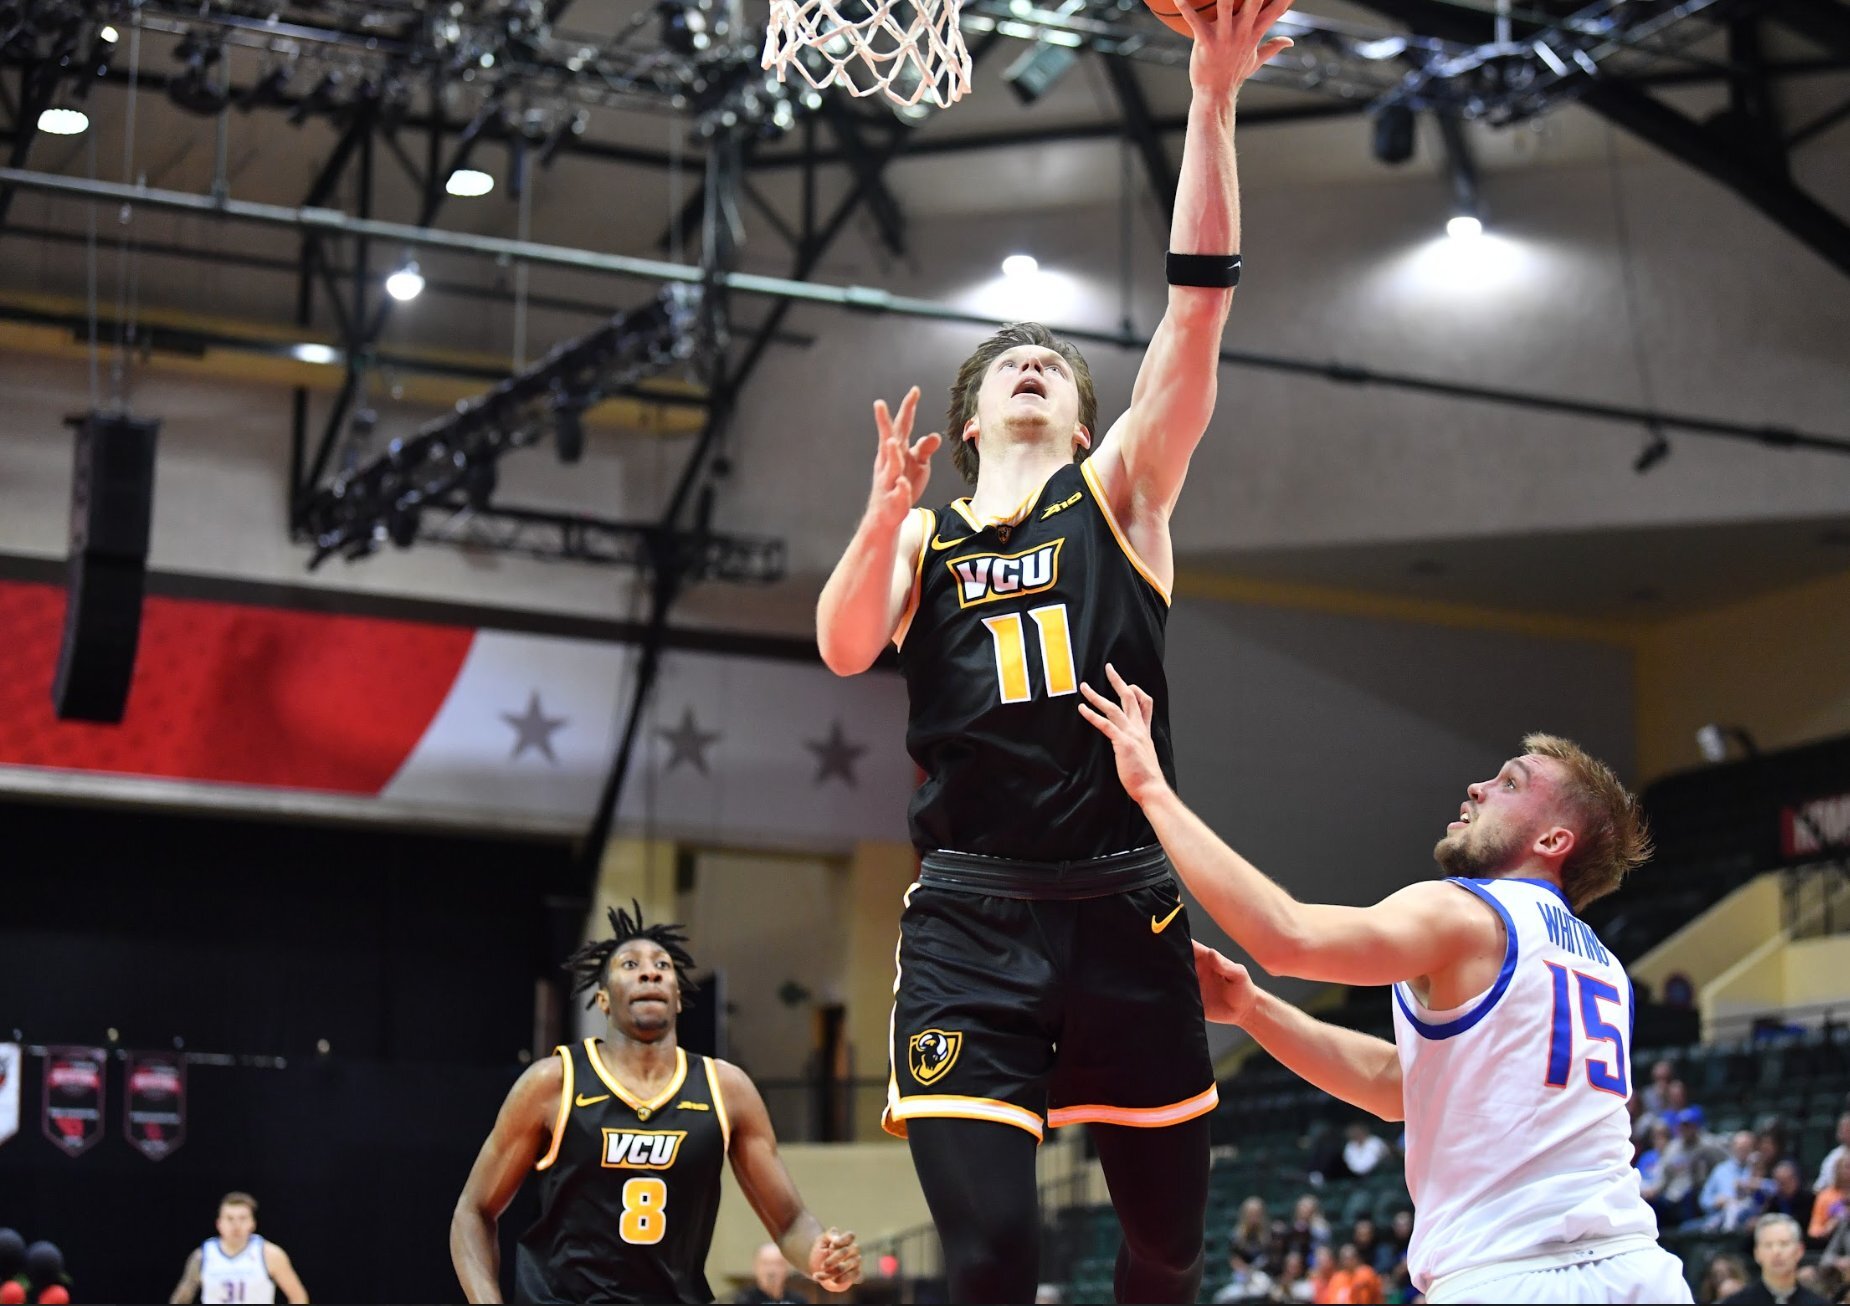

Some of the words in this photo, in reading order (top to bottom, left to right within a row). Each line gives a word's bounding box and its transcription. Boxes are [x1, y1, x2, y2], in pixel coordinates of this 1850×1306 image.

[955, 546, 1054, 601] VCU
[981, 603, 1078, 704] 11
[1542, 959, 1628, 1098] 15
[606, 1133, 679, 1164] VCU
[619, 1177, 668, 1245] 8
